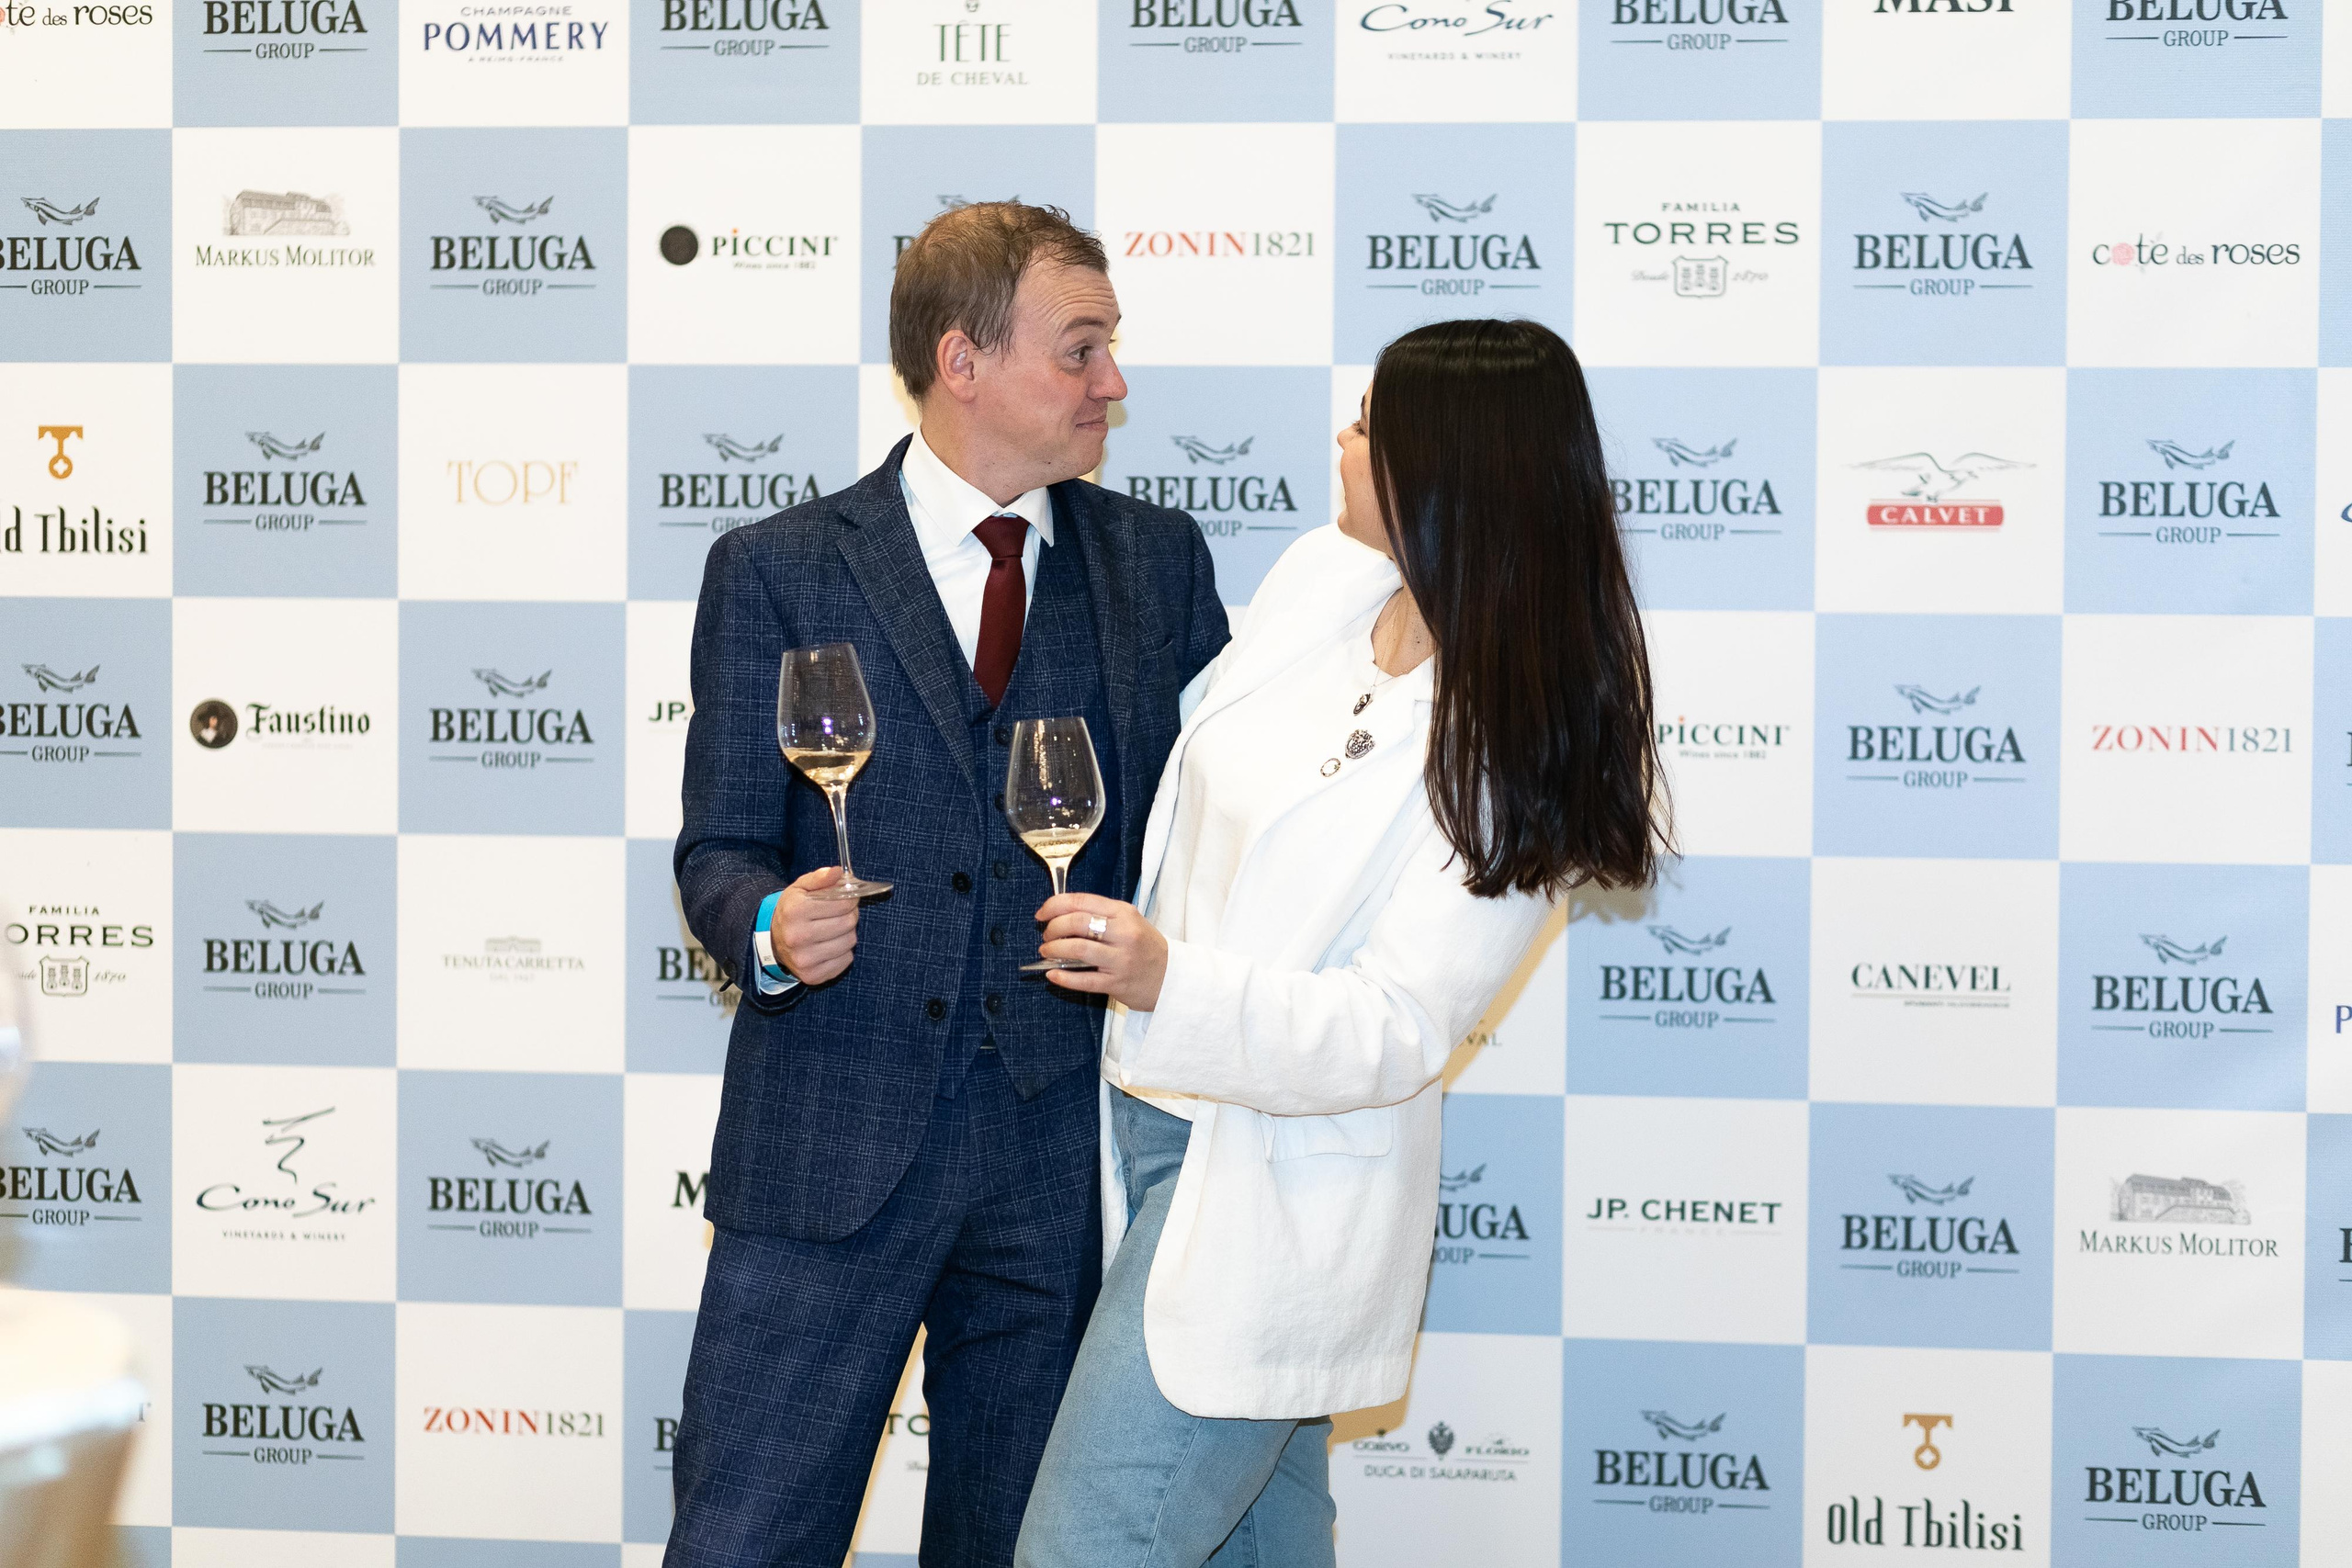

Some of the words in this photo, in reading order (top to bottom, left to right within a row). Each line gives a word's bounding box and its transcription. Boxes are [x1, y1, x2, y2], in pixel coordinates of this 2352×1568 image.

[42, 7, 67, 26] des
[74, 6, 153, 25] roses
[203, 0, 368, 34] BELUGA
[461, 5, 571, 17] CHAMPAGNE
[662, 0, 829, 31] BELUGA
[1130, 0, 1303, 28] BELUGA
[1360, 4, 1466, 37] Cono
[1464, 0, 1554, 37] Sur
[1611, 0, 1789, 25] BELUGA
[2106, 0, 2289, 21] BELUGA
[424, 22, 607, 51] POMMERY
[714, 39, 775, 56] GROUP
[1183, 37, 1248, 53] GROUP
[1667, 33, 1732, 51] GROUP
[2163, 30, 2229, 47] GROUP
[255, 43, 314, 59] GROUP
[917, 71, 941, 86] DE
[950, 71, 1027, 86] CHEVAL
[1662, 202, 1740, 212] FAMILIA
[1125, 232, 1313, 256] ZONIN1821
[1604, 222, 1799, 244] TORRES
[431, 235, 595, 271] BELUGA
[1367, 234, 1541, 270] BELUGA
[1854, 233, 2033, 270] BELUGA
[2177, 246, 2204, 265] des
[2211, 244, 2300, 265] roses
[31, 279, 89, 295] GROUP
[482, 279, 543, 296] GROUP
[1421, 278, 1485, 296] GROUP
[1910, 278, 1975, 296] GROUP
[204, 471, 367, 506] BELUGA
[447, 460, 578, 505] TOPF
[659, 473, 820, 509] BELUGA
[1128, 476, 1298, 513] BELUGA
[1611, 478, 1783, 515] BELUGA
[2099, 481, 2280, 518] BELUGA
[255, 514, 314, 531] GROUP
[1880, 506, 1990, 525] CALVET
[1196, 519, 1242, 537] OUP
[1661, 524, 1725, 541] GROUP
[2155, 526, 2222, 544] GROUP
[245, 702, 371, 736] Faustino
[430, 708, 594, 744] BELUGA
[1848, 726, 2026, 763] BELUGA
[2093, 726, 2290, 752] ZONIN1821
[32, 745, 89, 762] GROUP
[481, 751, 541, 769] GROUP
[1904, 771, 1968, 788] GROUP
[29, 905, 99, 916] FAMILIA
[6, 923, 154, 948] ORRES
[204, 939, 365, 976] BELUGA
[657, 946, 728, 983] BEL
[1600, 965, 1776, 1004] BELUGA
[1850, 963, 2011, 992] CANEVEL
[254, 982, 313, 998] GROUP
[2092, 976, 2273, 1014] BELUGA
[1655, 1010, 1720, 1029] GROUP
[2149, 1021, 2214, 1039] GROUP
[196, 1183, 296, 1213] Cono
[292, 1182, 377, 1219] Sur
[429, 1178, 592, 1214] BELUGA
[32, 1209, 89, 1225] GROUP
[1434, 1203, 1531, 1241] UGA
[1588, 1198, 1628, 1219] JP.
[1641, 1200, 1781, 1224] CHENET
[480, 1221, 539, 1238] GROUP
[1842, 1214, 2019, 1254] BELUGA
[2080, 1230, 2172, 1254] MARKUS
[2180, 1232, 2278, 1257] MOLITOR
[1433, 1247, 1476, 1266] OUP
[1896, 1260, 1962, 1279] GROUP
[203, 1404, 364, 1442] BELUGA
[424, 1407, 603, 1437] ZONIN1821
[254, 1447, 312, 1464] GROUP
[1364, 1463, 1407, 1479] DUCA
[1410, 1465, 1426, 1480] DI
[1595, 1450, 1770, 1490] BELUGA
[2085, 1467, 2267, 1507] BELUGA
[1648, 1495, 1713, 1515] GROUP
[1827, 1495, 1883, 1545] Old
[2142, 1514, 2207, 1531] GROUP
